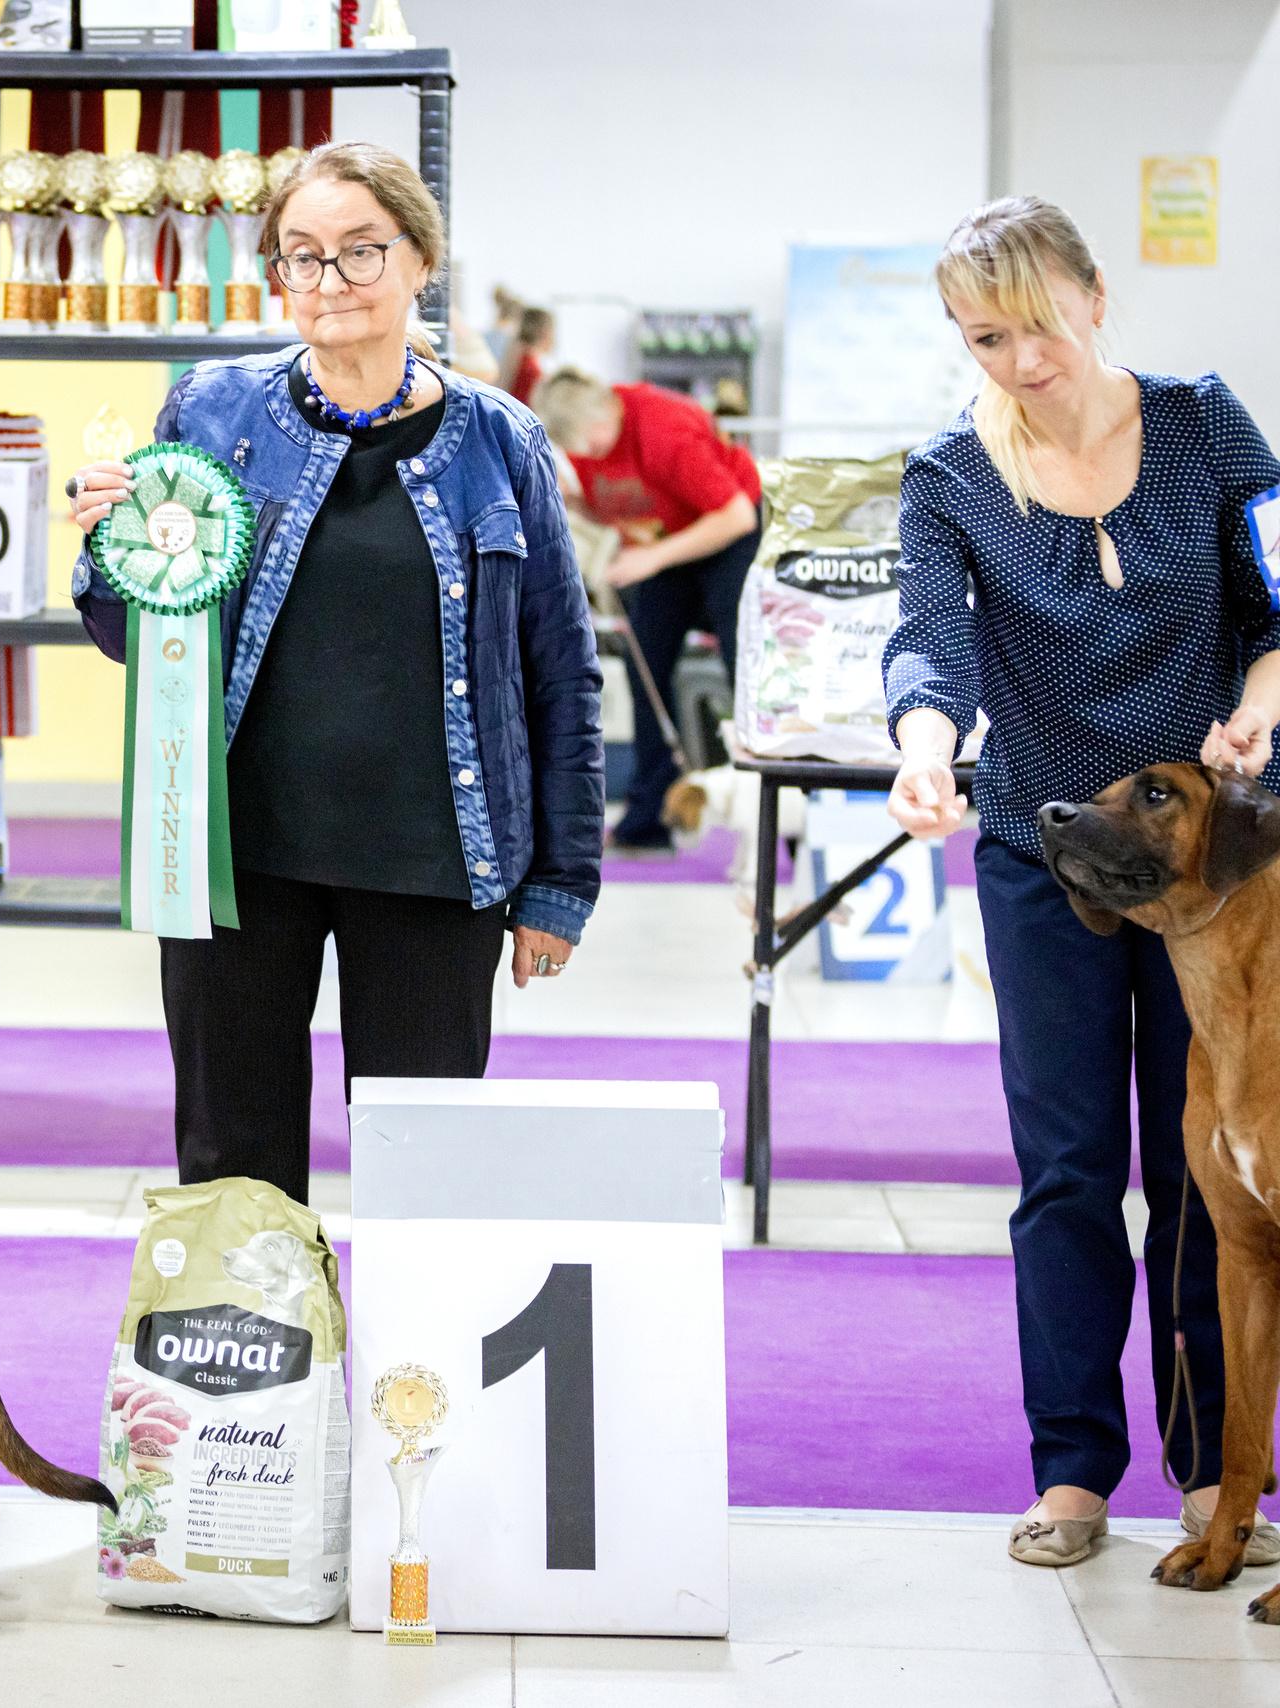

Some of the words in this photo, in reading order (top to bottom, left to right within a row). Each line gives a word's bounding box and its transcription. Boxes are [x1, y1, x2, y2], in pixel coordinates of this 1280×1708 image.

[794, 557, 892, 584] ownat
[159, 739, 186, 895] WINNER
[860, 864, 909, 934] 2
[183, 1317, 204, 1329] THE
[207, 1319, 233, 1331] REAL
[236, 1323, 267, 1336] FOOD
[157, 1334, 285, 1372] ownat
[195, 1371, 238, 1386] Classic
[482, 1263, 596, 1571] 1
[199, 1420, 287, 1449] natural
[193, 1443, 297, 1469] INGREDIENTS
[206, 1462, 250, 1487] fresh
[252, 1463, 295, 1485] duck
[188, 1518, 210, 1528] PULSES
[219, 1521, 255, 1532] LEGUMBRES
[218, 1557, 252, 1573] DUCK
